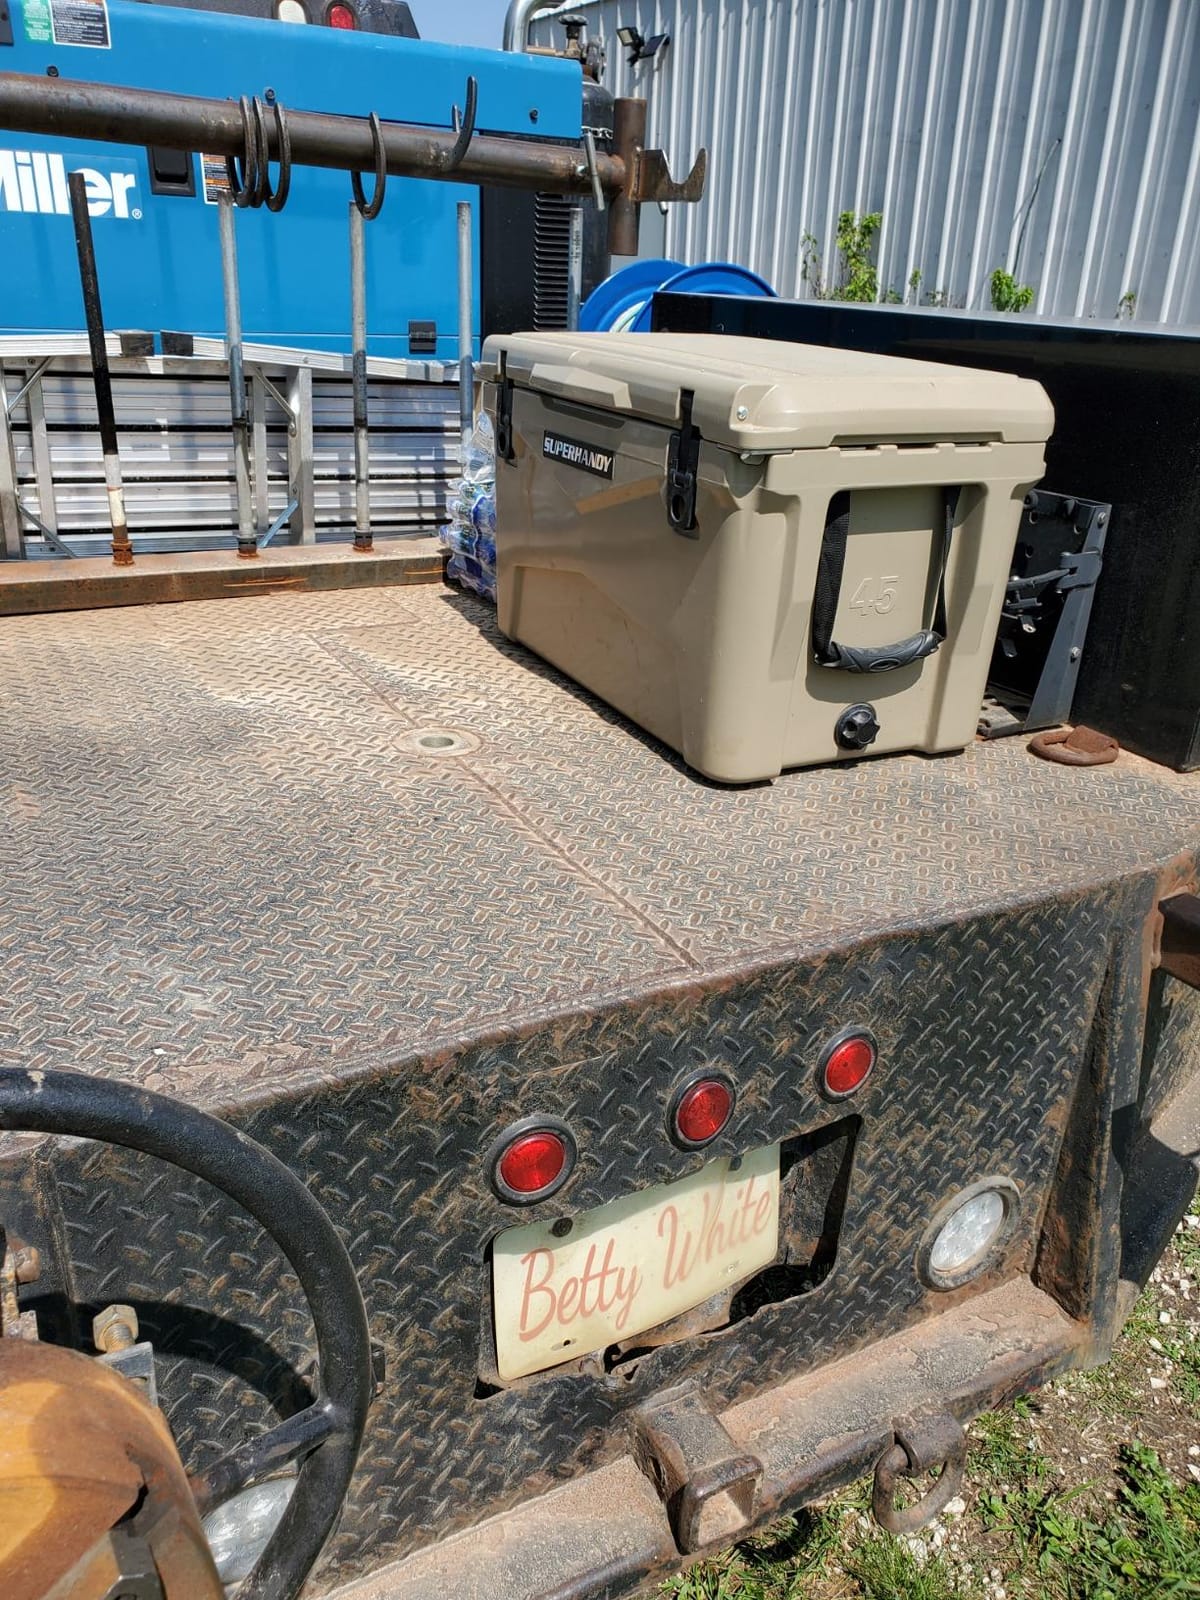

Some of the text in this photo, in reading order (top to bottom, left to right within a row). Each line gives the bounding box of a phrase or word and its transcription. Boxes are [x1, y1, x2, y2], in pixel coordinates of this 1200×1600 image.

[543, 437, 612, 472] SUPERHANDY
[848, 575, 899, 617] 45
[519, 1174, 771, 1343] Betty White
